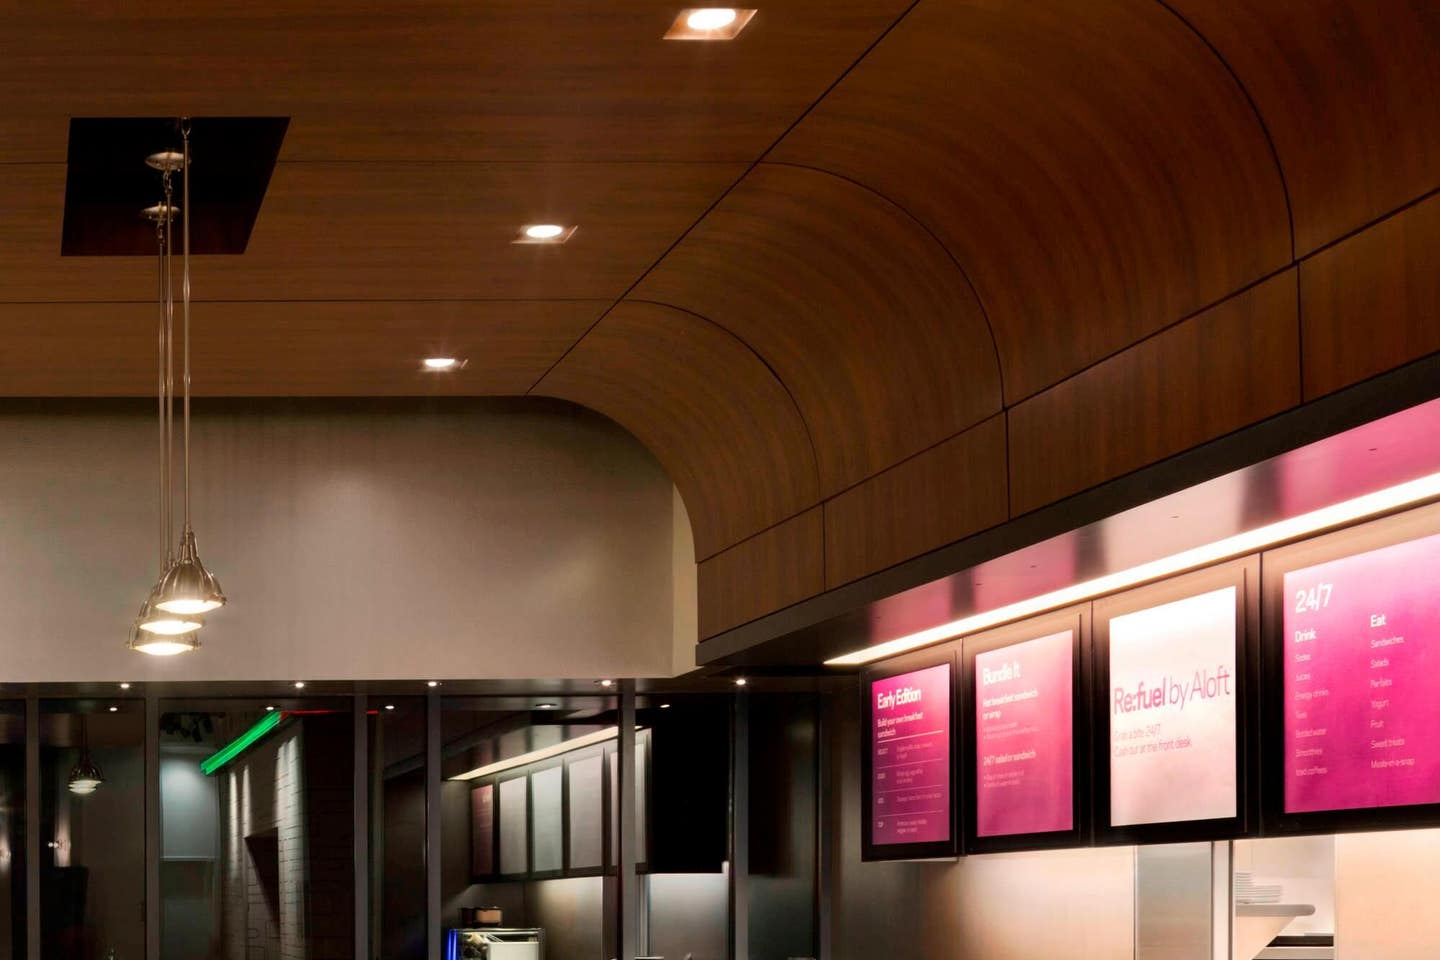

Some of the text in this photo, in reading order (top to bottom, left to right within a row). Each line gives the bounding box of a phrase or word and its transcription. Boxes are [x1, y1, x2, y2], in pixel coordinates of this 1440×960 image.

[1295, 583, 1333, 613] 24/7
[1370, 614, 1386, 628] Eat
[1295, 628, 1316, 643] Drink
[1370, 635, 1405, 649] Sandwiches
[1370, 657, 1389, 669] Salads
[983, 663, 1012, 686] Bundle
[1114, 665, 1230, 715] Re:fuel by Aloft
[877, 686, 922, 710] Early Edition
[1370, 699, 1389, 710] Yogurt
[1370, 719, 1384, 728] Fruit
[1159, 739, 1174, 751] front
[1175, 736, 1192, 750] desk
